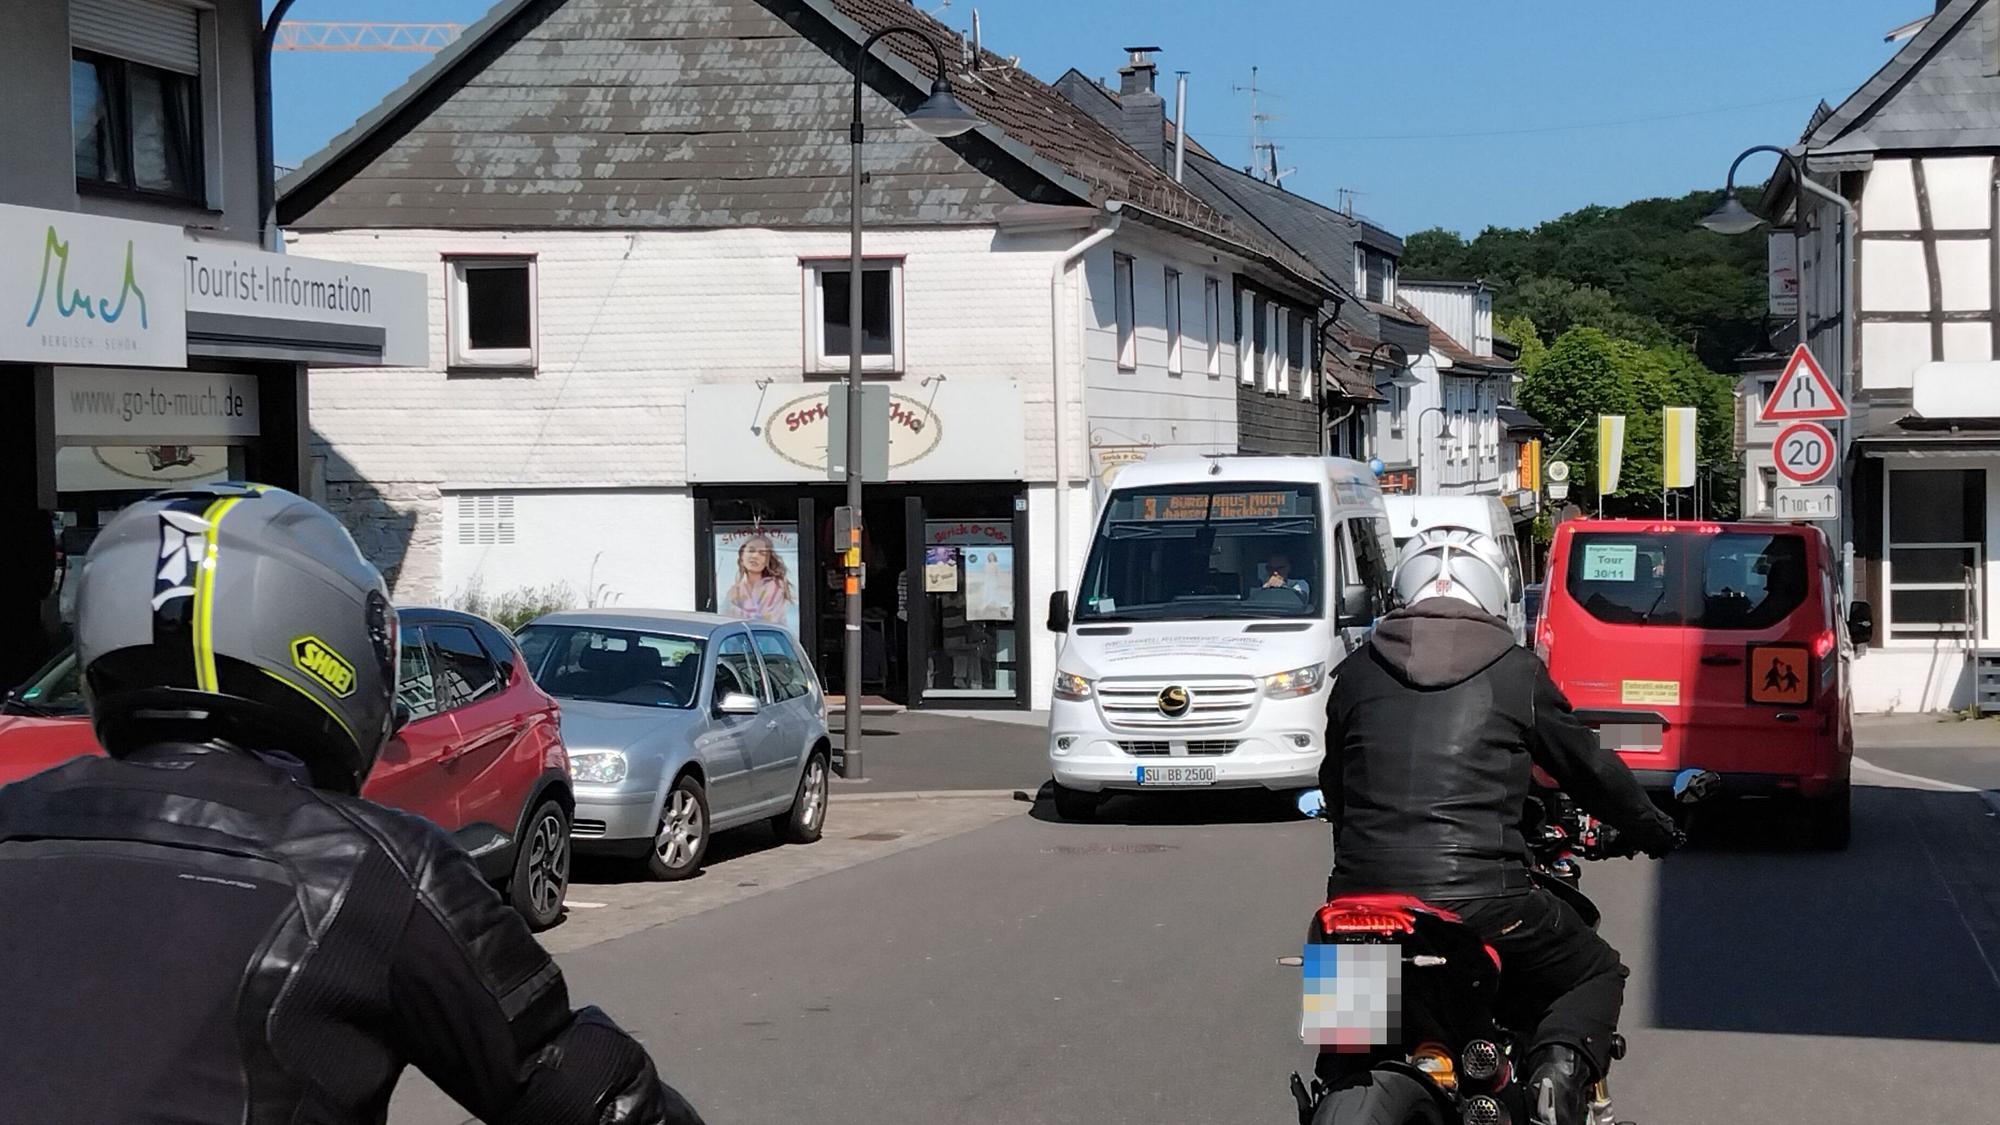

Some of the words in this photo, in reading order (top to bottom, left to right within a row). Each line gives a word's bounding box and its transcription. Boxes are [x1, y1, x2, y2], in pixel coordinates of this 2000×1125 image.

[26, 225, 148, 330] Much
[186, 255, 372, 313] Tourist-Information
[41, 335, 94, 348] BERGISCH
[105, 337, 138, 351] SCHÖN
[69, 384, 244, 422] www.go-to-much.de
[1787, 439, 1821, 466] 20
[1250, 493, 1286, 507] MUCH
[1597, 555, 1624, 565] Tour
[300, 642, 353, 693] SHOEI
[1145, 768, 1160, 781] SU
[1167, 768, 1182, 781] BB
[1184, 768, 1213, 781] 2500
